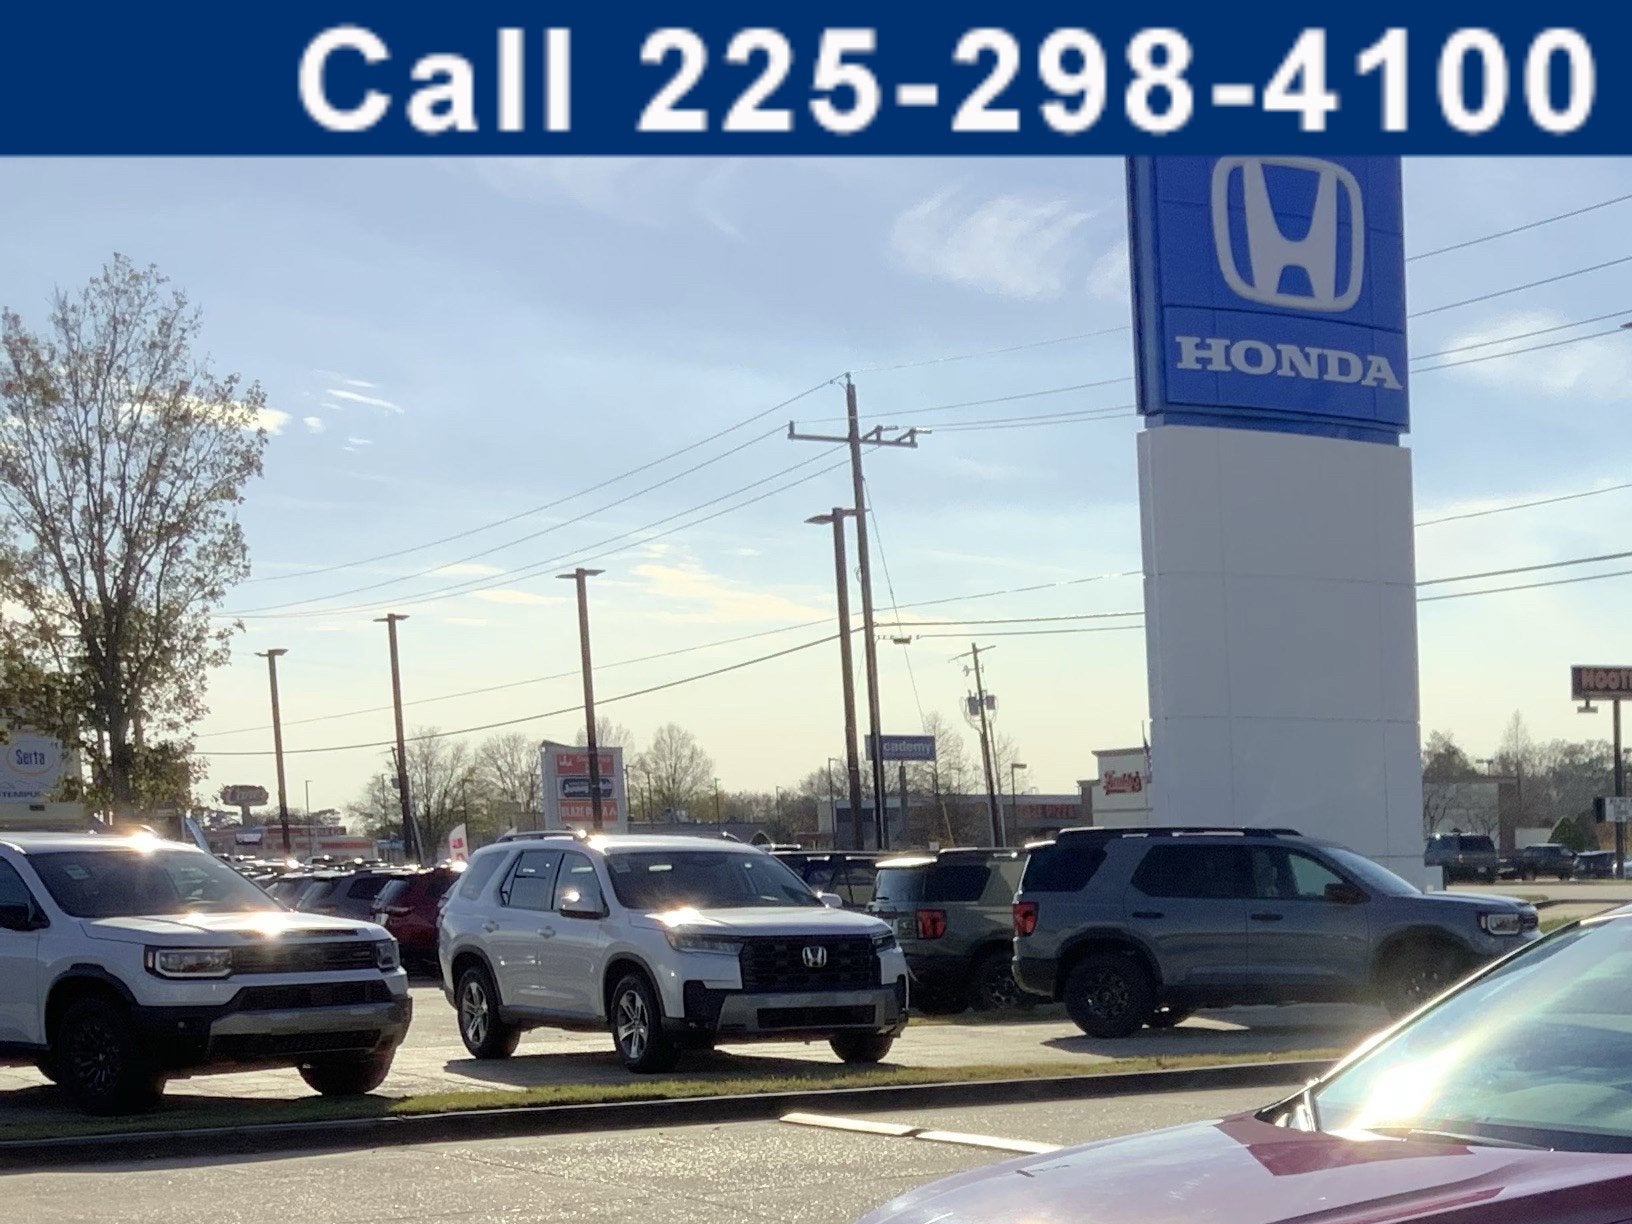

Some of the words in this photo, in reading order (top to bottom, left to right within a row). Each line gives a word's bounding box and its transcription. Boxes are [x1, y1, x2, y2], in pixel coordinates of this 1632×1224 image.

[1175, 335, 1403, 390] HONDA
[883, 740, 931, 754] cademy
[15, 749, 45, 765] Serta
